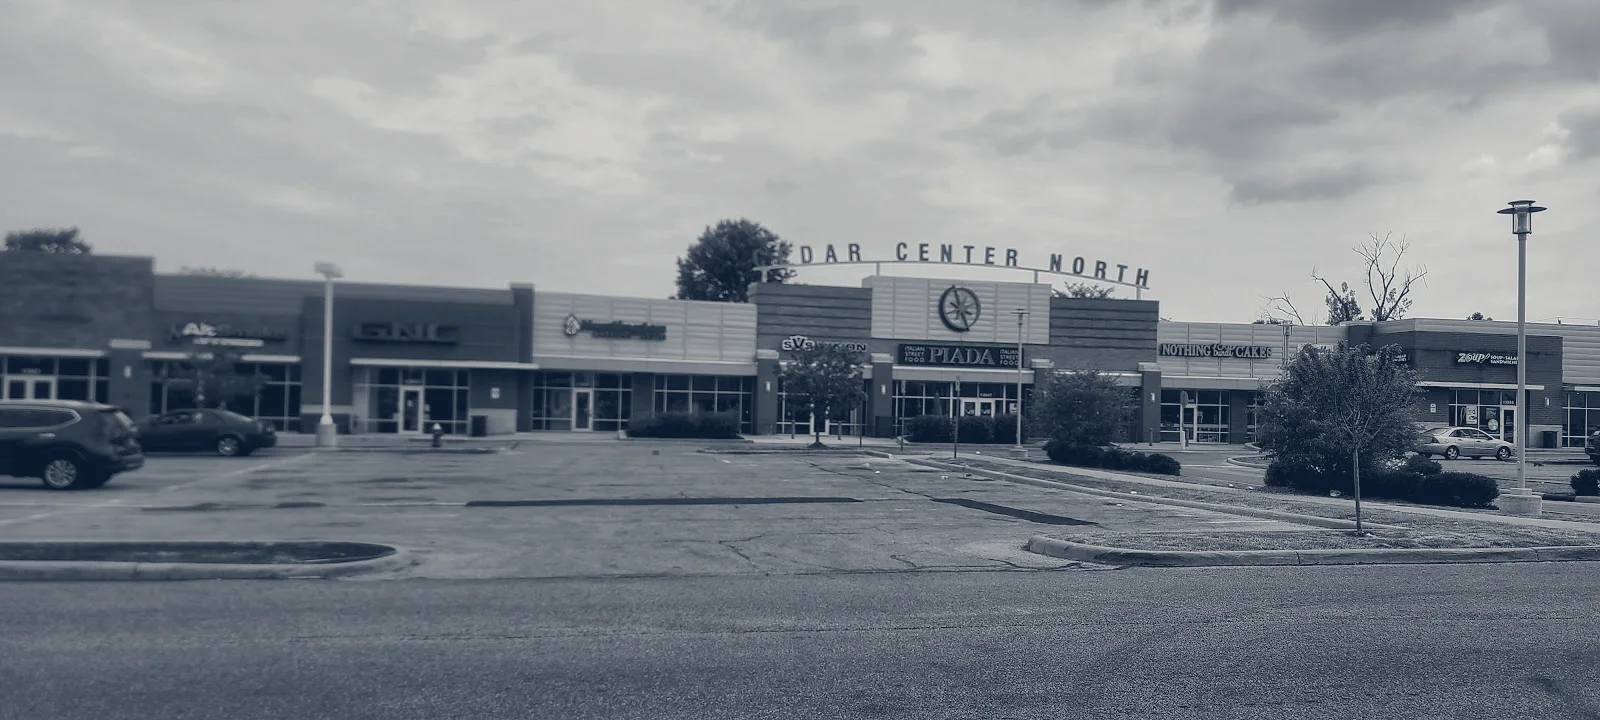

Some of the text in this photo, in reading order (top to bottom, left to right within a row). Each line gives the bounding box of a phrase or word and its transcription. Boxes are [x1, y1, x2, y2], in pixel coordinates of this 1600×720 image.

[753, 242, 1150, 287] CDAR CENTER NORTH
[353, 322, 457, 341] GNC
[928, 347, 995, 364] PIADA
[1161, 344, 1211, 356] NOTHING
[1235, 346, 1272, 358] CAKES
